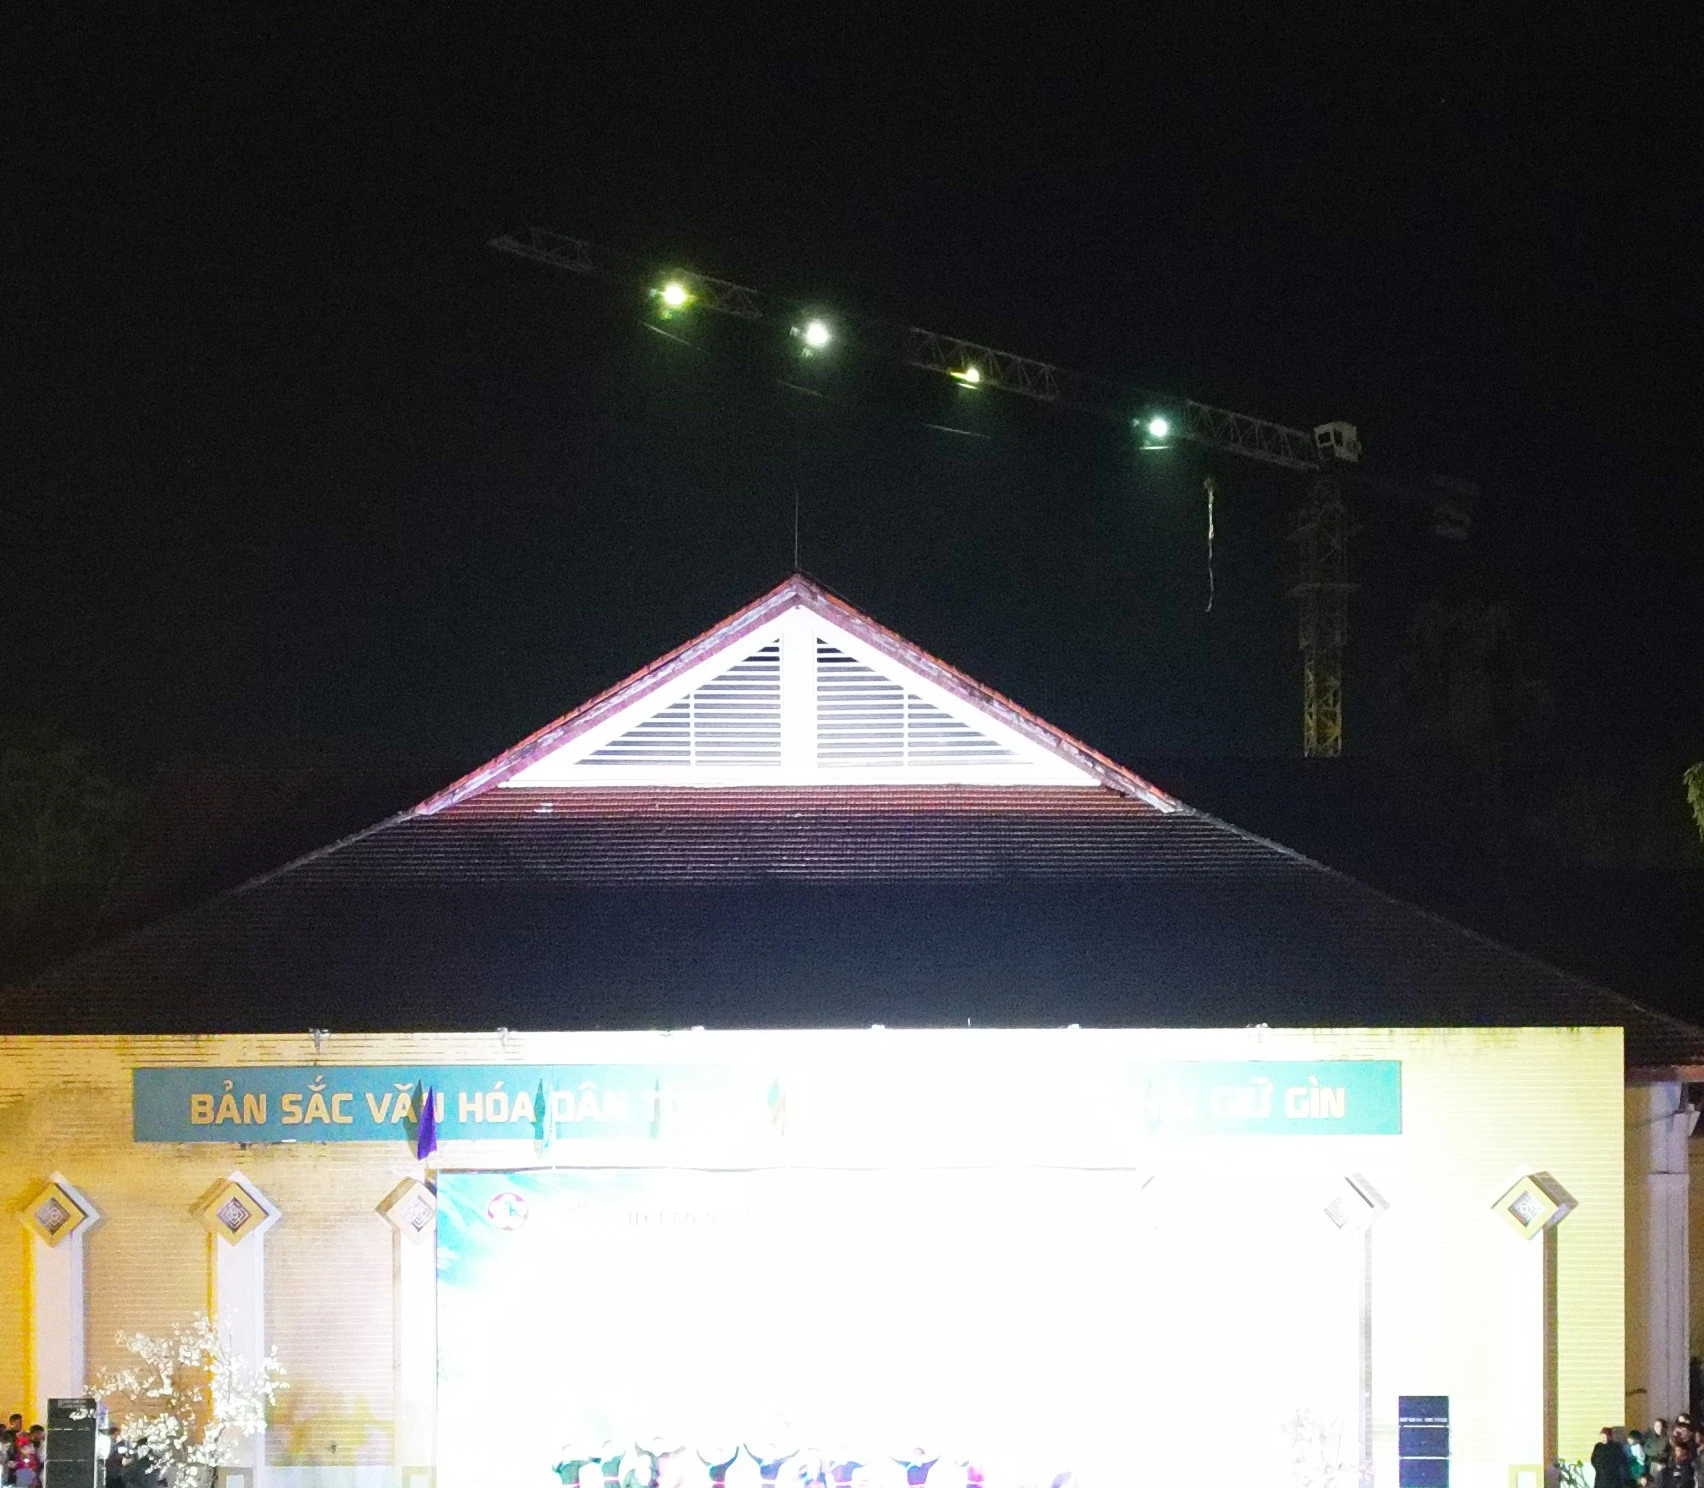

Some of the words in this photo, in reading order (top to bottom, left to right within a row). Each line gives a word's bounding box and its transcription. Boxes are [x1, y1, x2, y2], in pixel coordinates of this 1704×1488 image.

[190, 1078, 267, 1125] BẢN
[282, 1075, 354, 1125] SẮC
[458, 1081, 537, 1124] HÓA
[1284, 1075, 1346, 1119] GÌN
